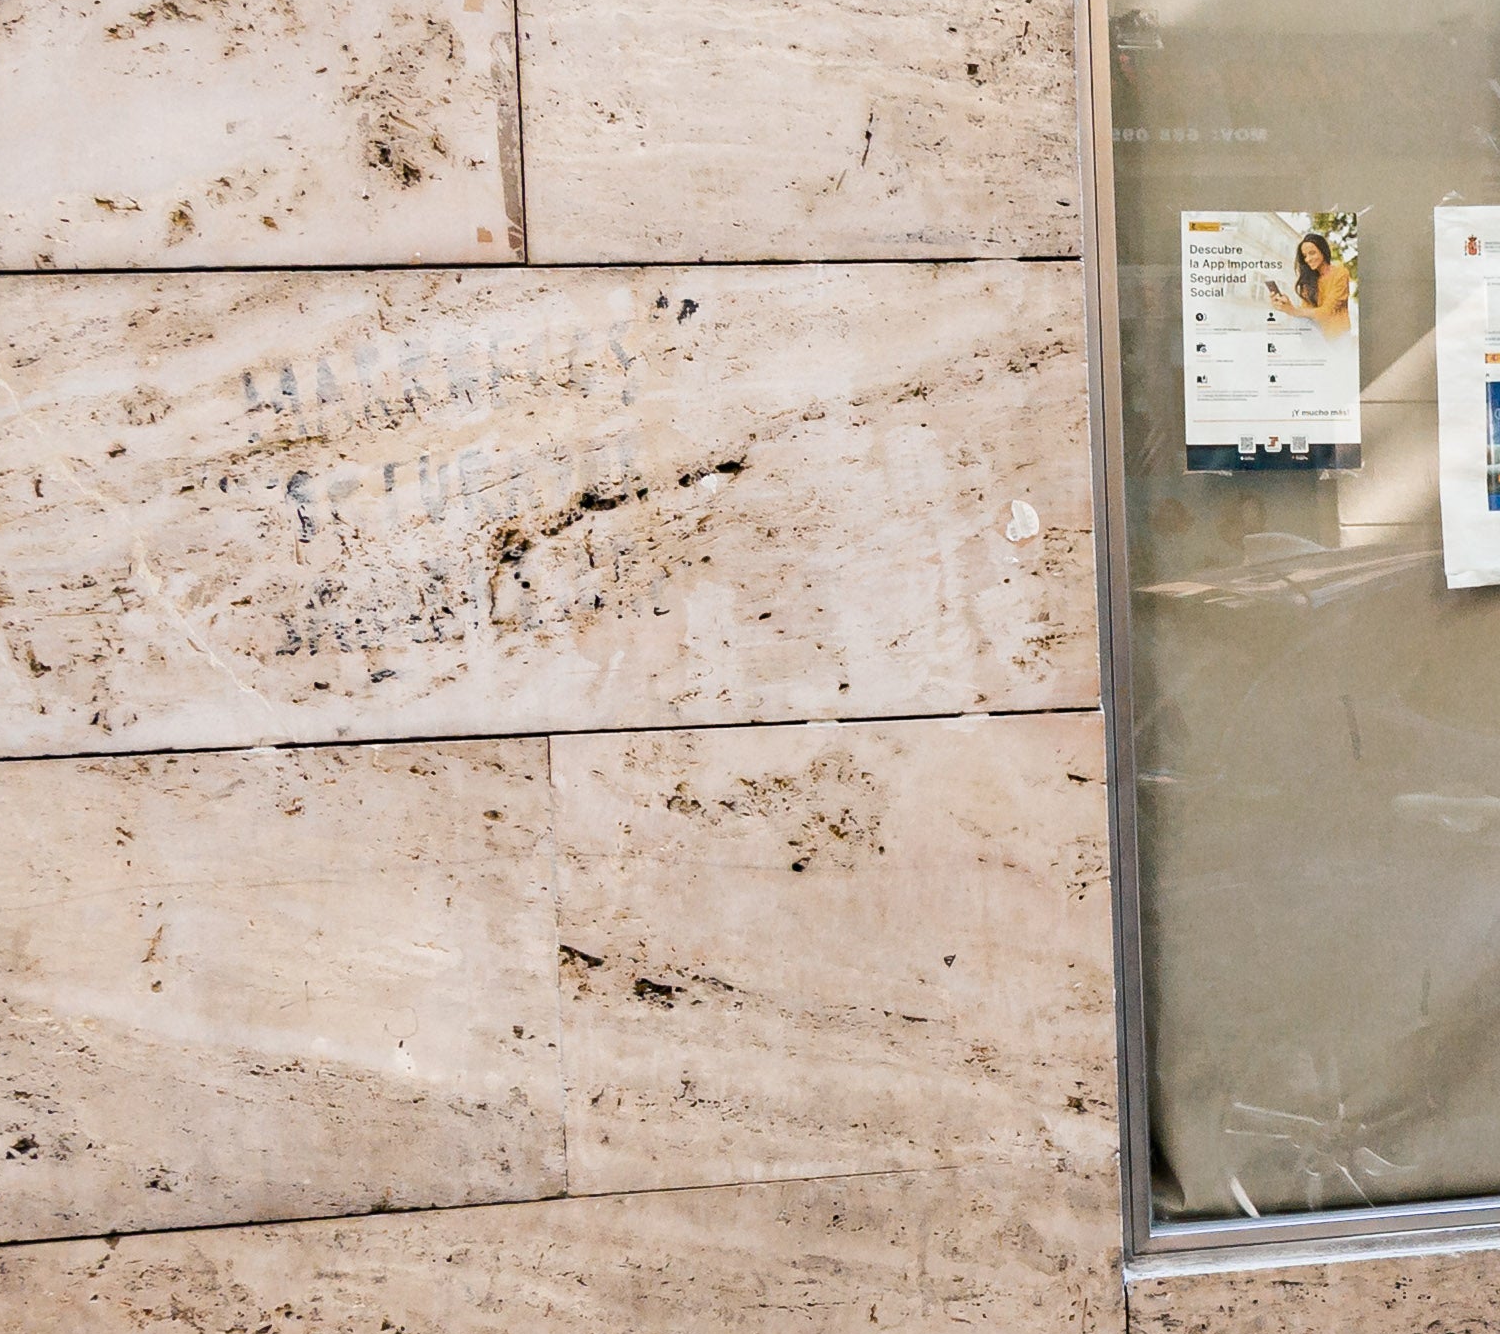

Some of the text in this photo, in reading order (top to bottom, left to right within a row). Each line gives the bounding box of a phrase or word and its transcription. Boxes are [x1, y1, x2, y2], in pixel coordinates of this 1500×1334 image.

[1189, 244, 1243, 255] Descubre
[1189, 259, 1283, 271] la App Importass
[1190, 273, 1247, 286] Seguridad
[1190, 288, 1224, 298] Social
[1302, 408, 1329, 417] mucho
